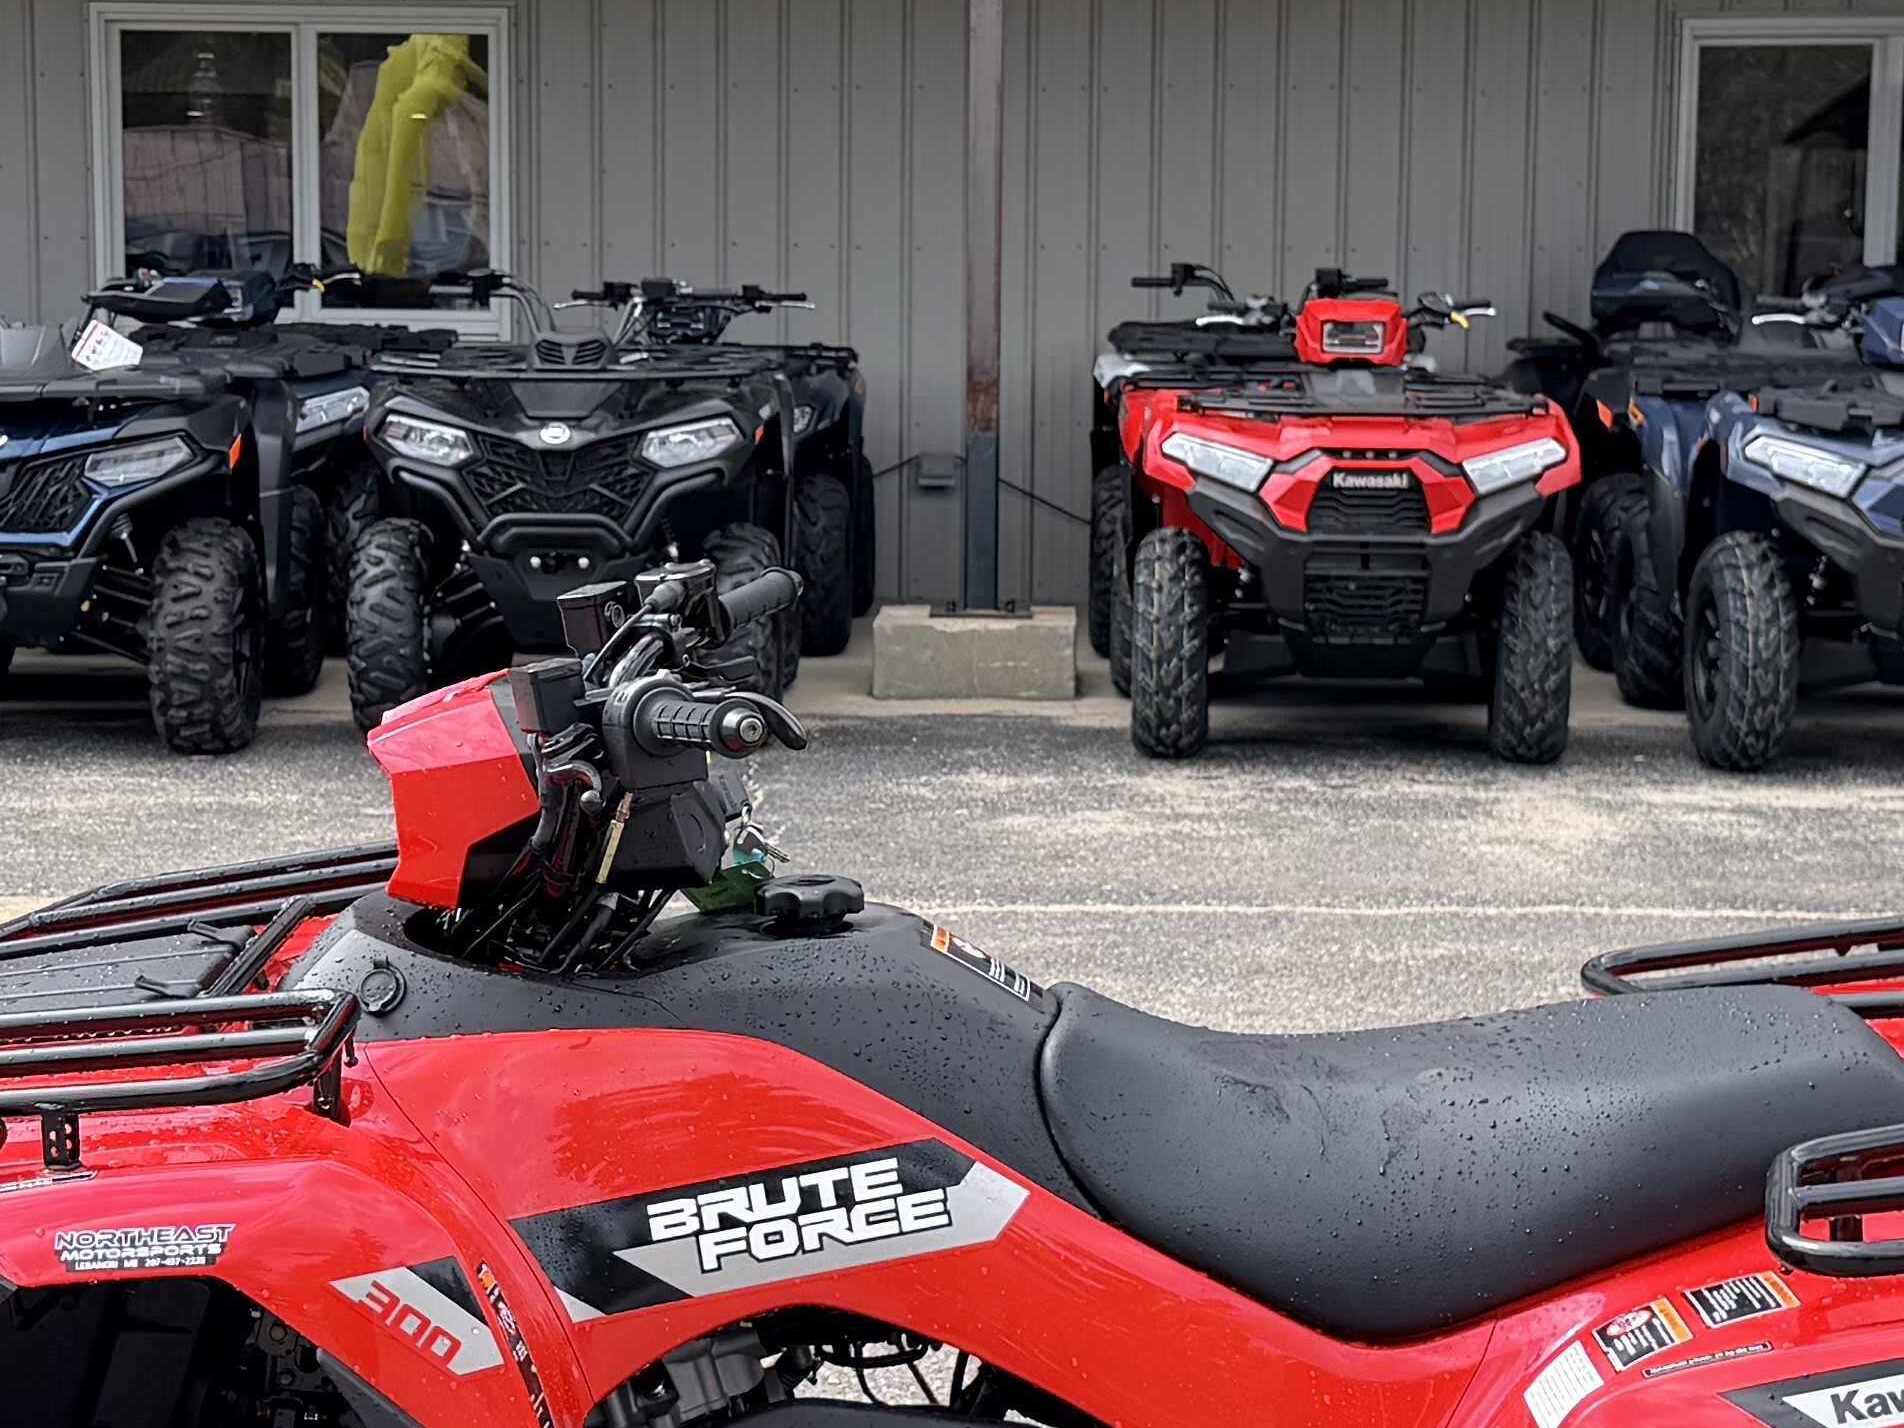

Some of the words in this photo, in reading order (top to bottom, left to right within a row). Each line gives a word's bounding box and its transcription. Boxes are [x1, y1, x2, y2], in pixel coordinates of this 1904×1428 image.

[1332, 471, 1409, 489] Kawasaki
[647, 1157, 904, 1241] BRUTE
[54, 1224, 236, 1250] NORTHEAST
[60, 1243, 222, 1262] MOTORSPORTS
[697, 1188, 951, 1273] FORCE
[358, 1279, 463, 1368] 300
